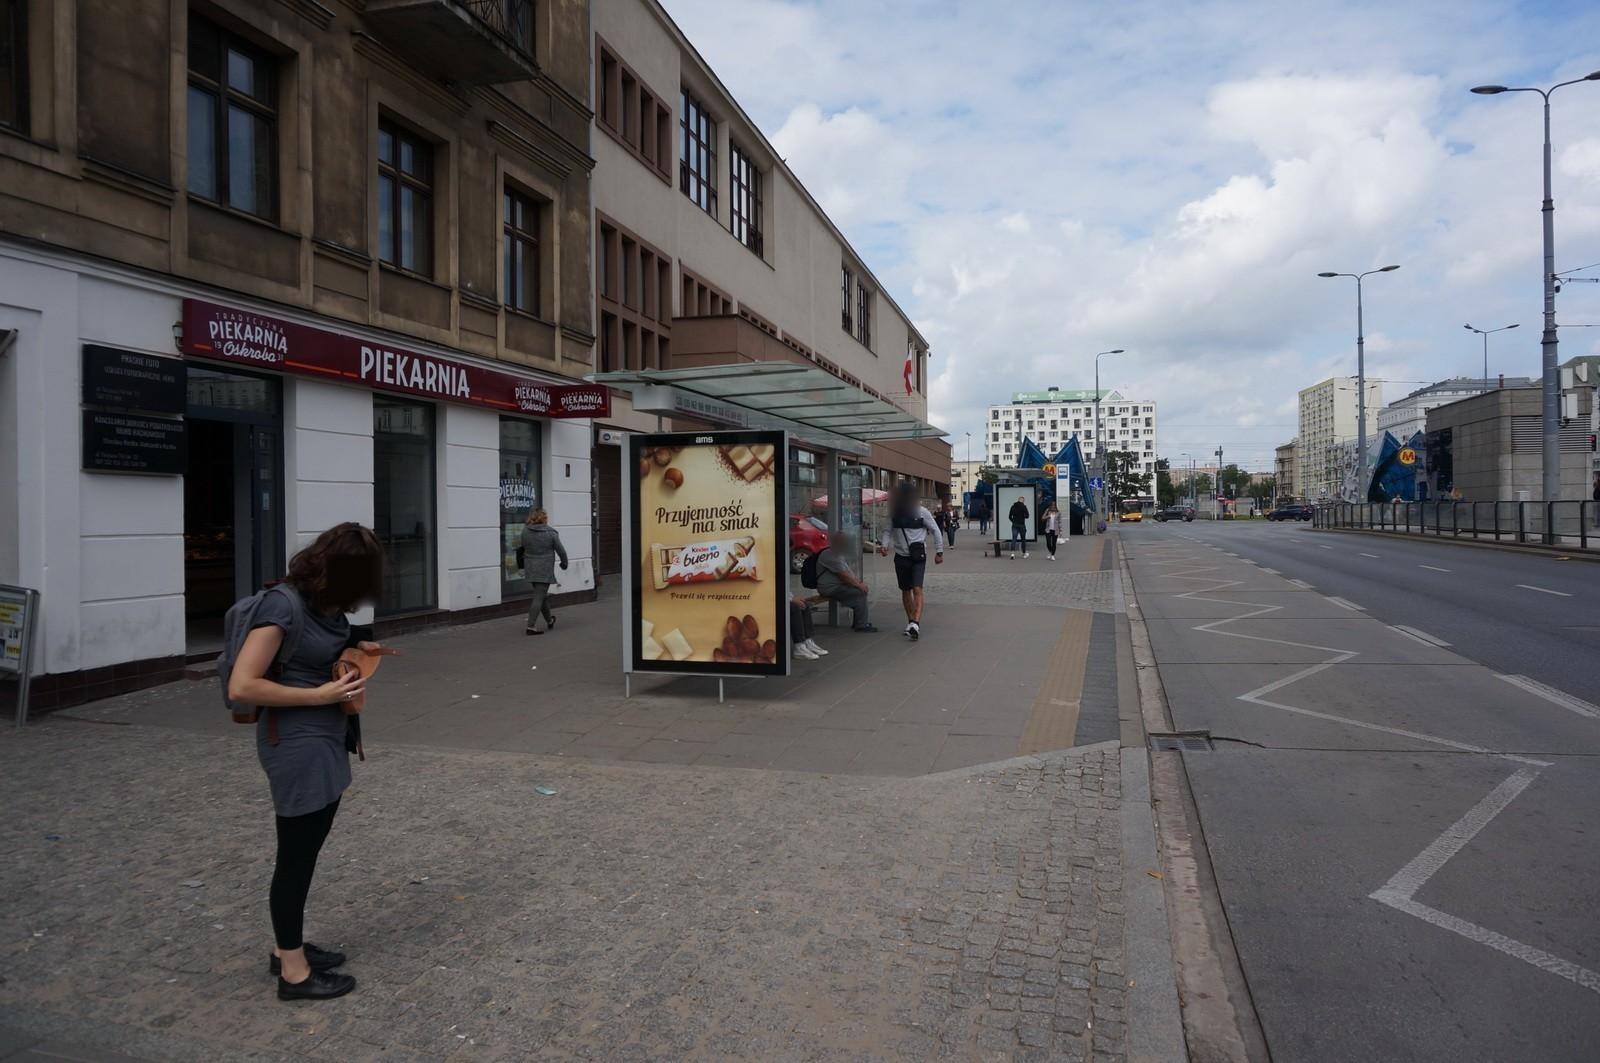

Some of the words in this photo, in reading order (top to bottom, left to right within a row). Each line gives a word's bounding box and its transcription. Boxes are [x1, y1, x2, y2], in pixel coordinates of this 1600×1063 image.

[209, 320, 288, 354] PIEKARNIA
[223, 341, 276, 362] Oskroba
[361, 346, 470, 398] PIEKARNIA
[515, 387, 551, 406] PIEKARNIA
[560, 395, 603, 405] PIEKARNIA
[655, 500, 744, 527] Przyjemność
[692, 520, 716, 533] ma
[720, 513, 759, 531] smak
[684, 551, 720, 567] bueno
